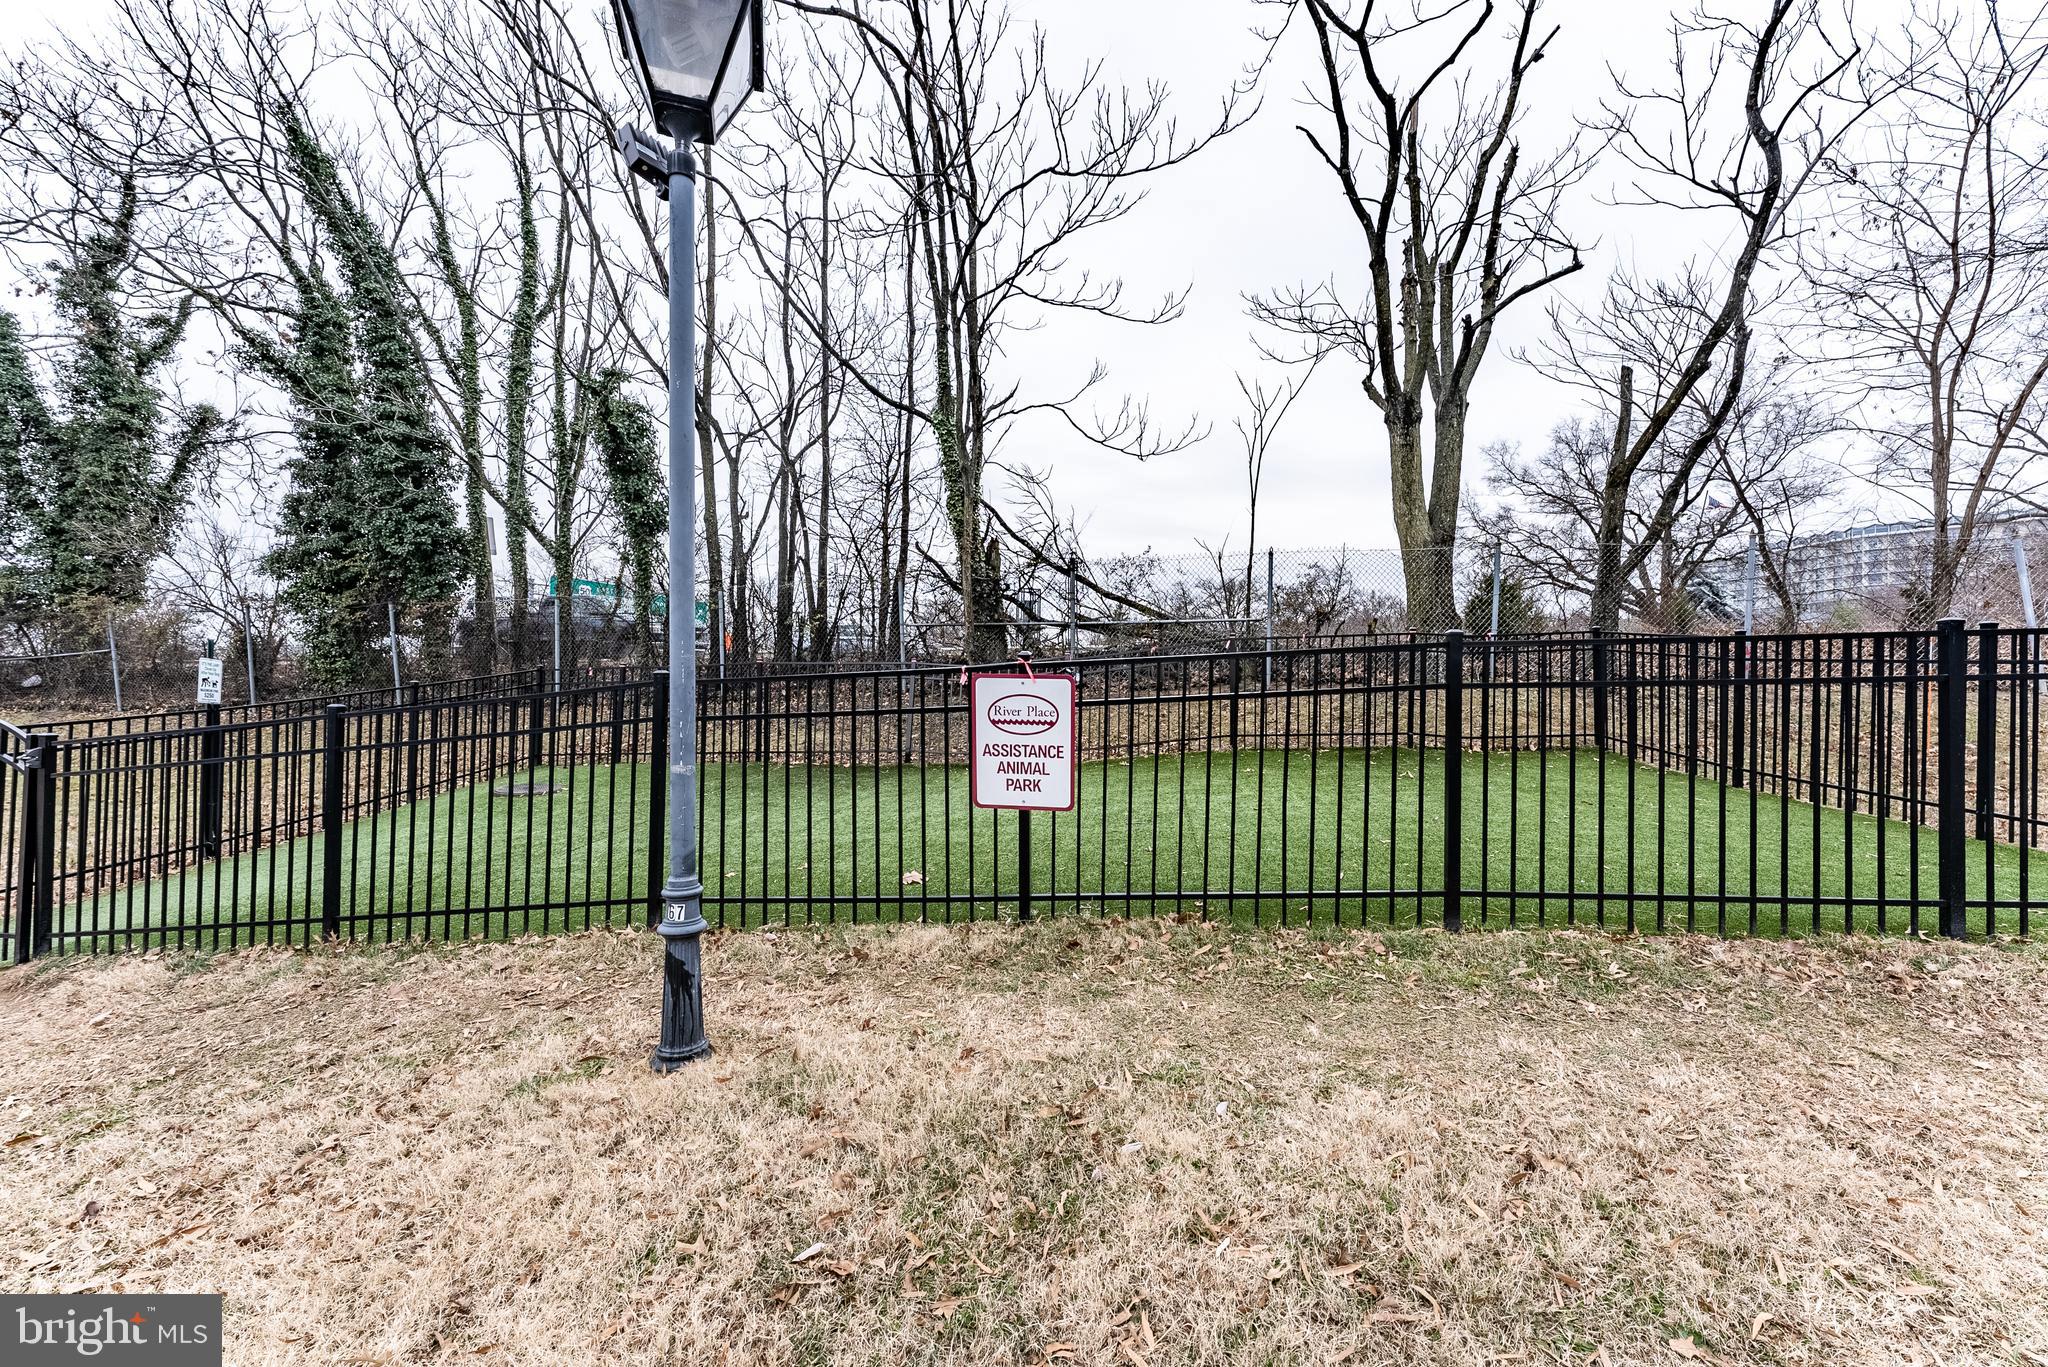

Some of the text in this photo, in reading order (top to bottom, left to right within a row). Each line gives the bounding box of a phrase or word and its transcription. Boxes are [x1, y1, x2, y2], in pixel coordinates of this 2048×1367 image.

[994, 705, 1056, 717] River Place
[982, 743, 1064, 759] ASSISTANCE
[996, 761, 1050, 776] ANIMAL
[1006, 778, 1042, 792] PARK
[669, 904, 684, 920] 67
